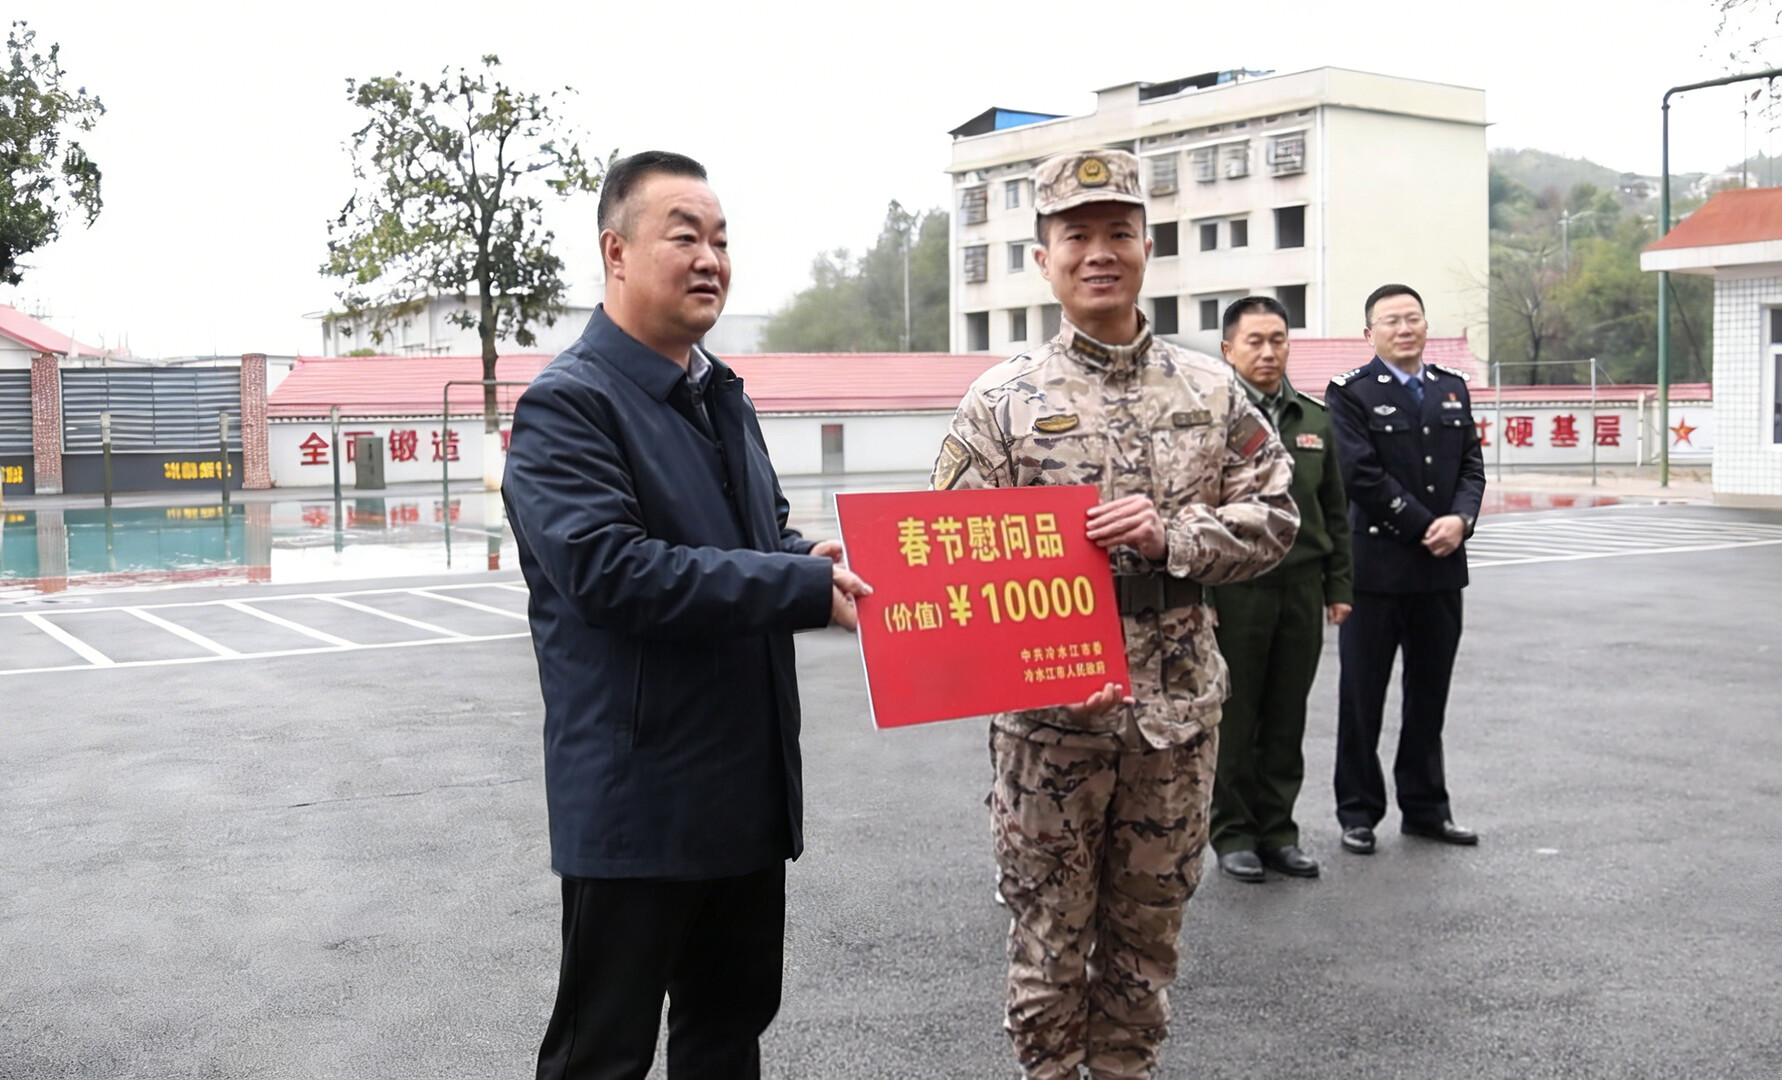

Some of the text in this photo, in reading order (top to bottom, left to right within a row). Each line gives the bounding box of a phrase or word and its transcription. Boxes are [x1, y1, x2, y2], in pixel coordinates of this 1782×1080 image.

[897, 513, 1064, 567] 春节慰问品
[1020, 640, 1103, 663] 中共冷水江市委
[1023, 660, 1106, 683] 冷水江市人民政府
